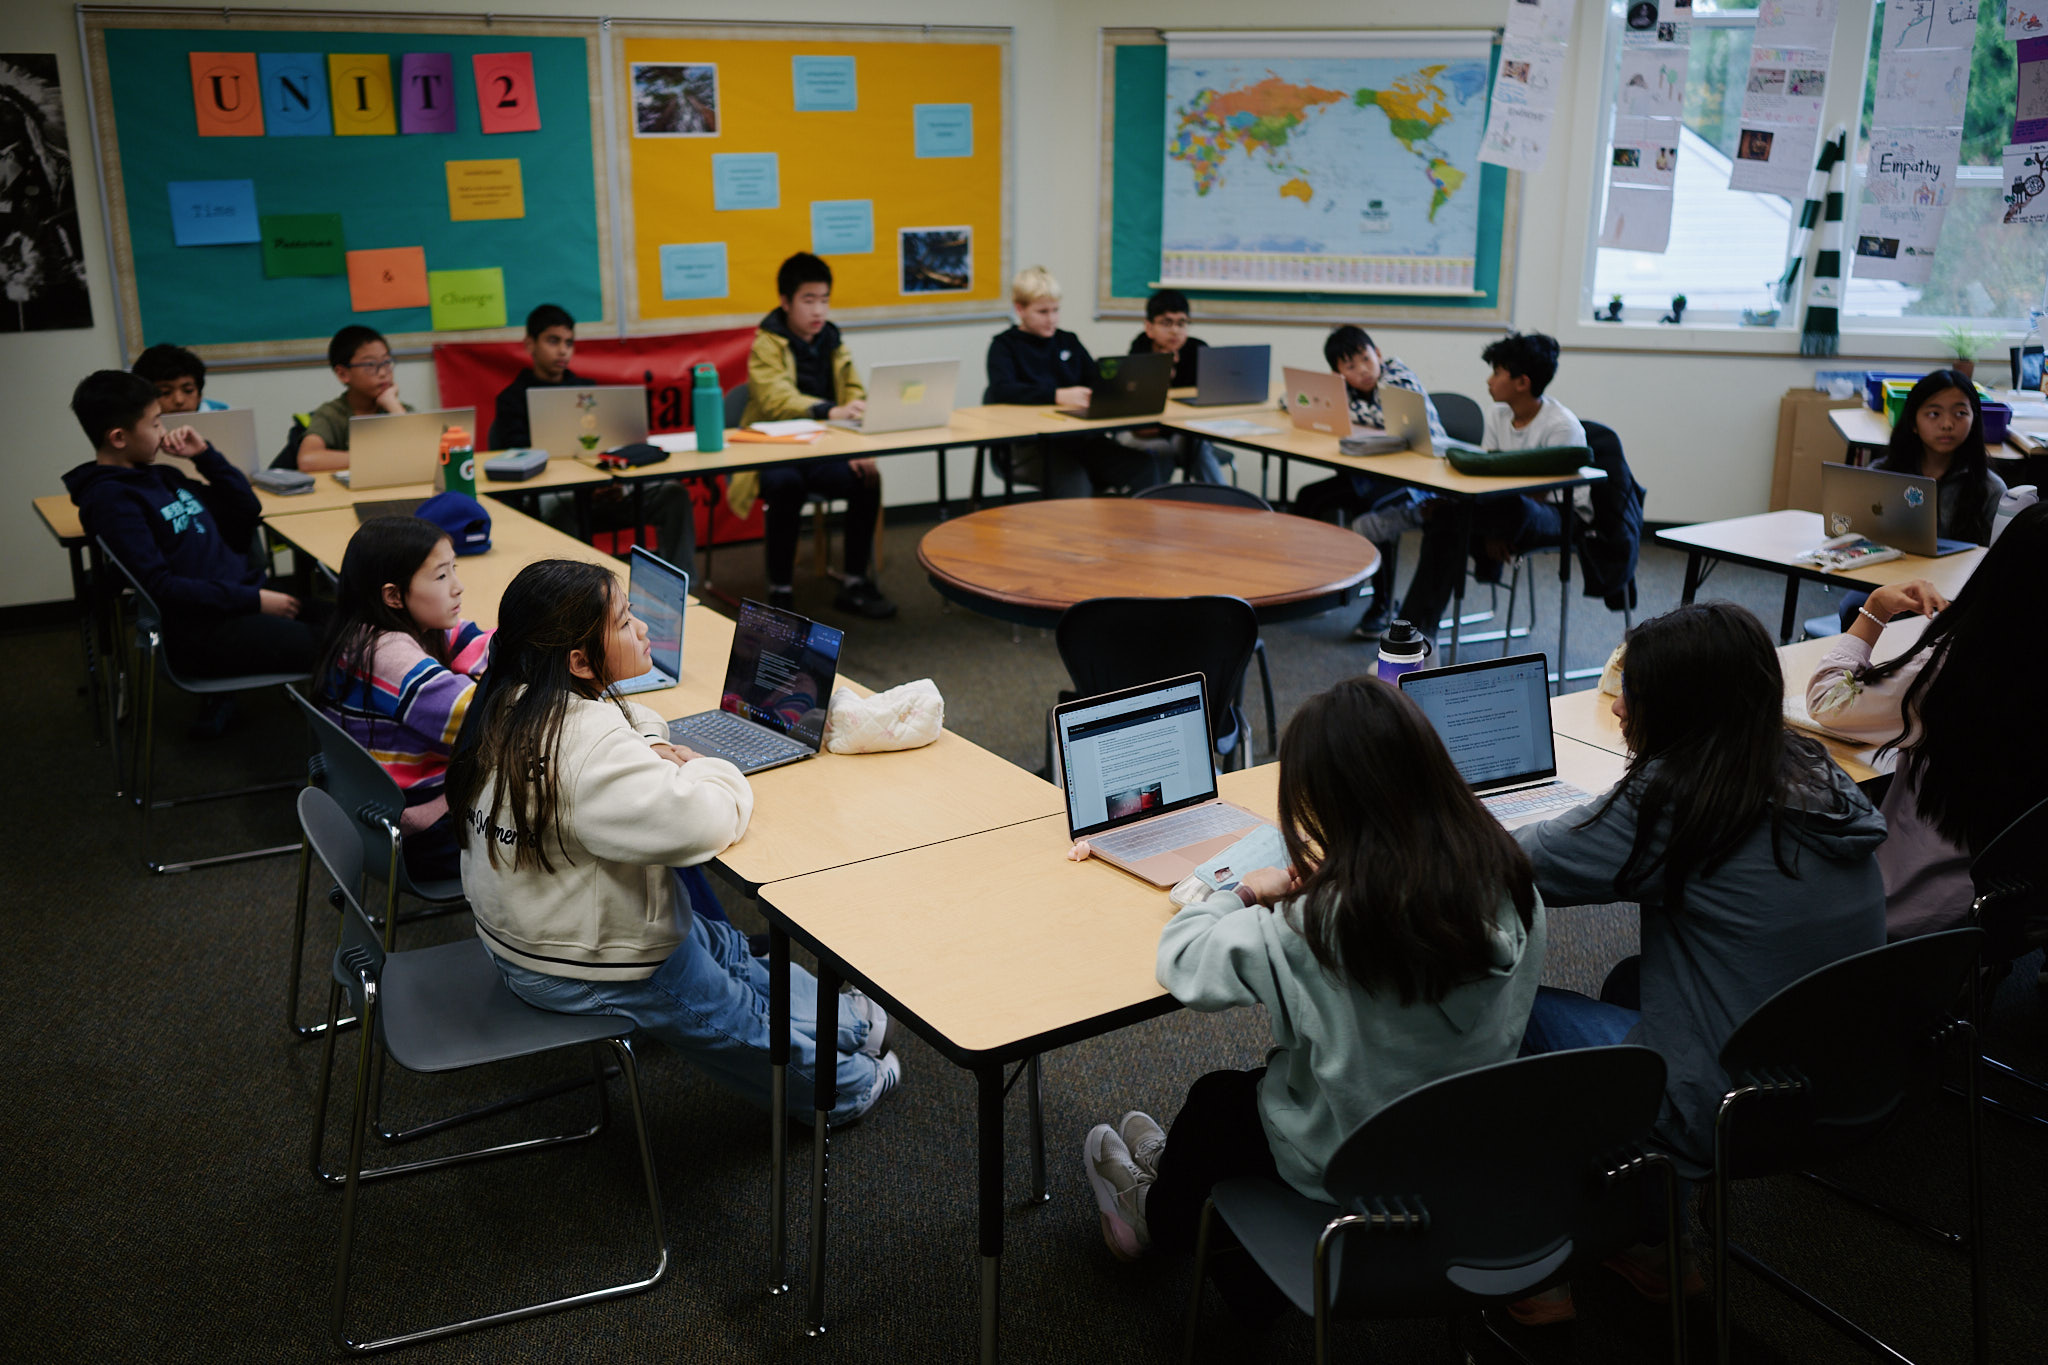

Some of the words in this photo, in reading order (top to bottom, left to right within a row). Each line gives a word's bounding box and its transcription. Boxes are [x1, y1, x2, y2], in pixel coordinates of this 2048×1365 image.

[209, 74, 441, 113] UNIT
[494, 75, 518, 109] 2
[1879, 152, 1941, 182] Empathy
[382, 269, 394, 283] &
